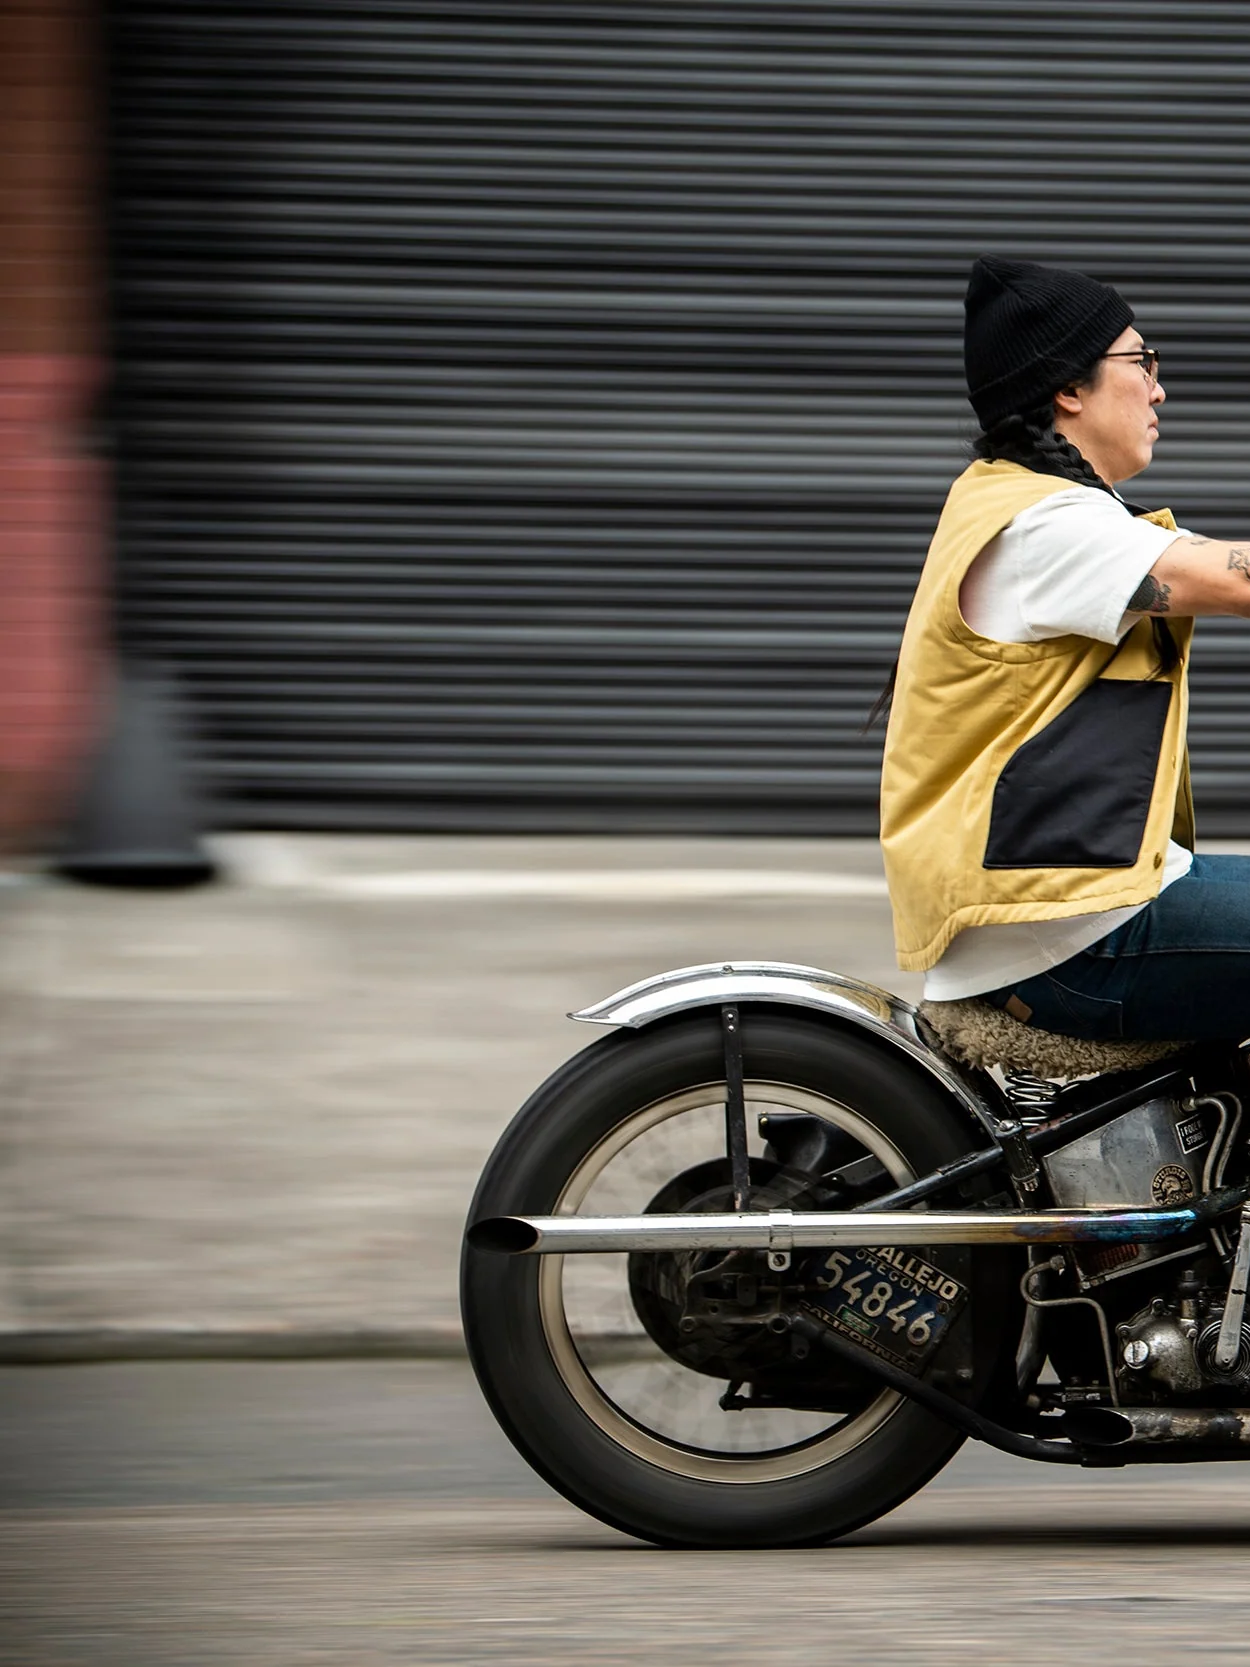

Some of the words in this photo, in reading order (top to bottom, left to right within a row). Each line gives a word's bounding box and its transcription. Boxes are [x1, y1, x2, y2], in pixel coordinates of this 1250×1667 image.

[1154, 1167, 1185, 1189] STURGIS
[816, 1251, 936, 1346] 54846
[855, 1249, 924, 1297] OREGON
[867, 1247, 959, 1301] ALLEJO
